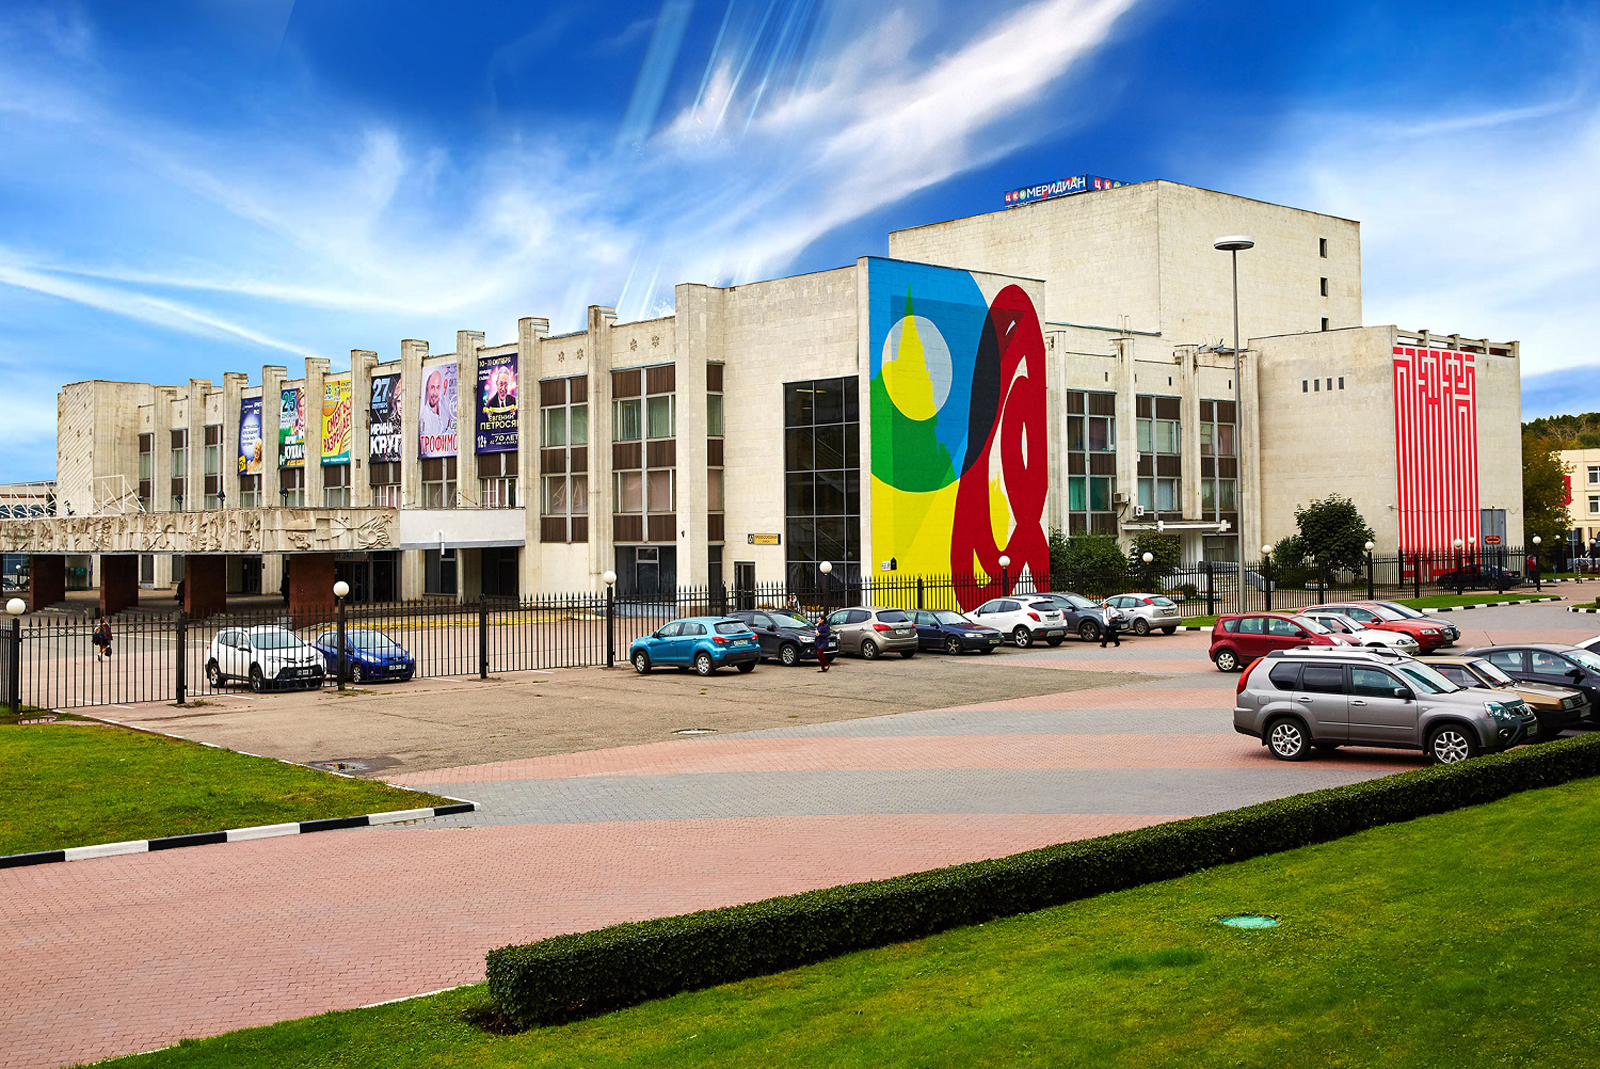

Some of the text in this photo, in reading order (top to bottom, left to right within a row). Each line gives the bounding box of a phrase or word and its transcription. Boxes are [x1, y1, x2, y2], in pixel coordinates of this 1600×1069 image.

[1027, 177, 1086, 198] МЕРИДИАН
[372, 378, 390, 403] 27
[282, 392, 296, 412] 25
[480, 420, 518, 431] ПЕТРОСЯ
[488, 413, 514, 422] ЕВГЕНИЙ
[370, 422, 393, 435] ИРИНА
[370, 434, 402, 455] КРУГ
